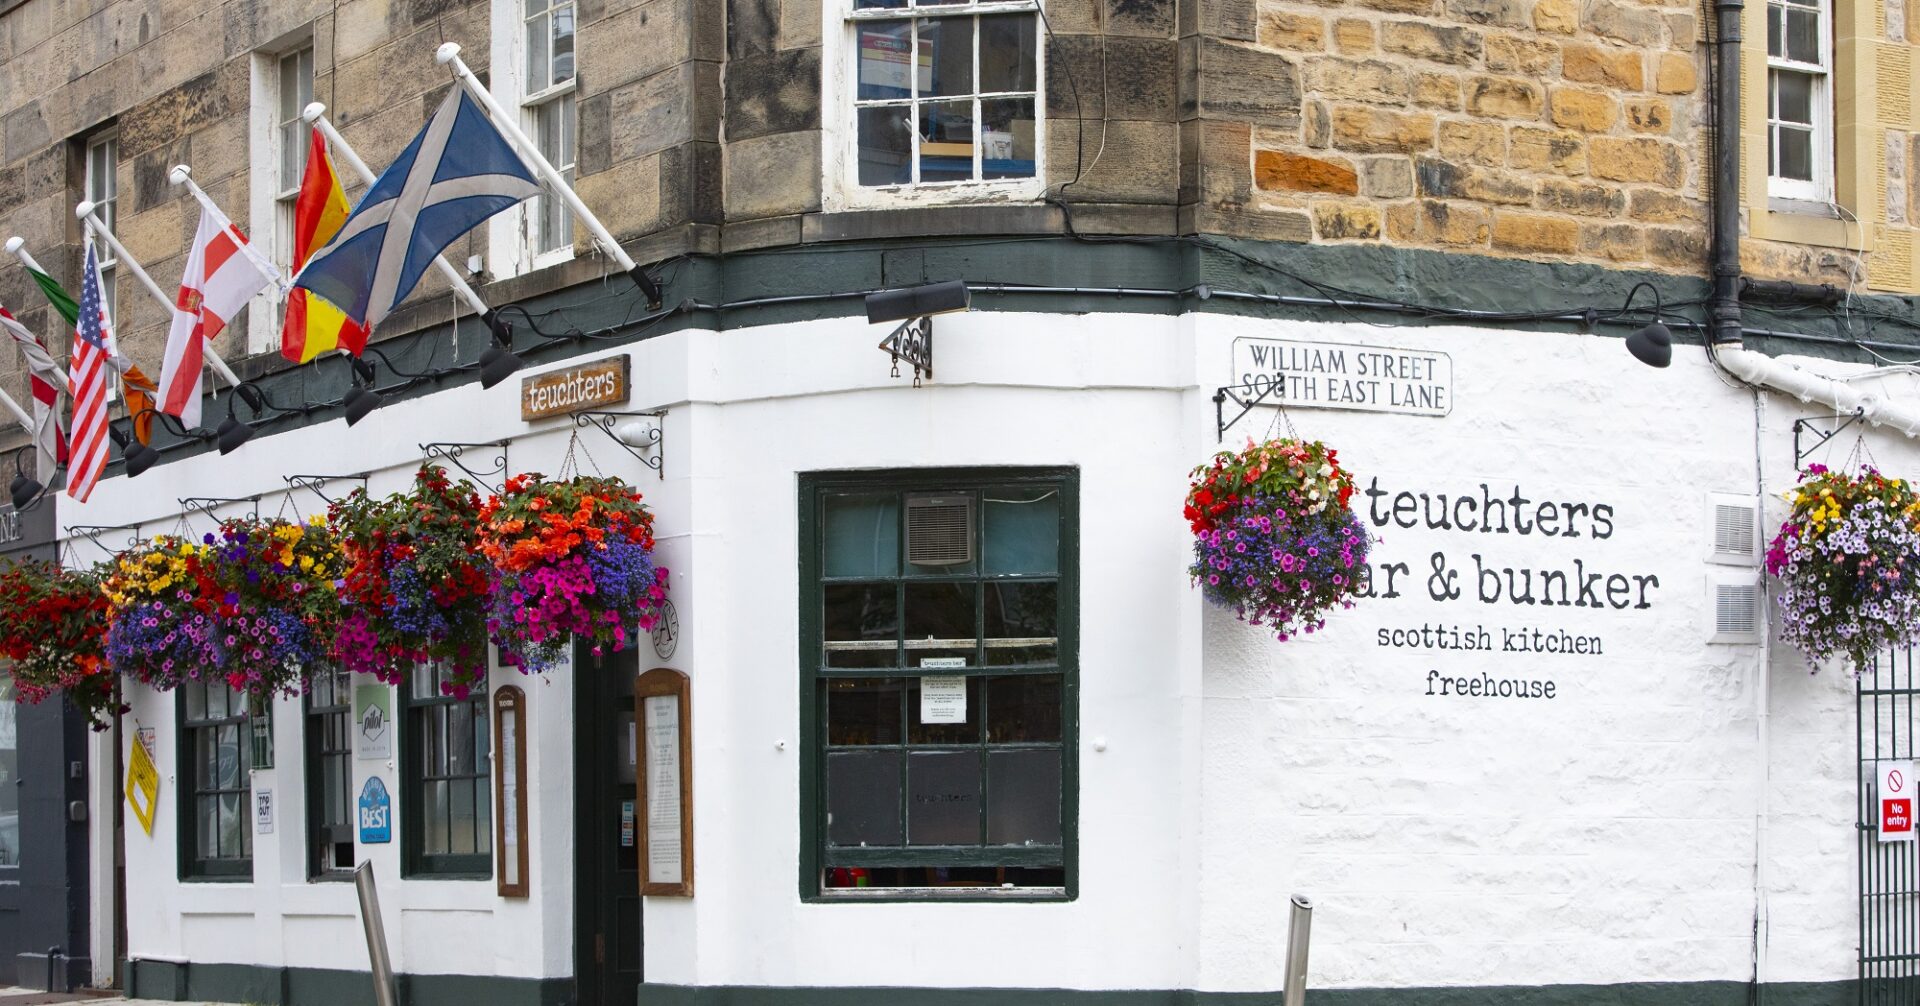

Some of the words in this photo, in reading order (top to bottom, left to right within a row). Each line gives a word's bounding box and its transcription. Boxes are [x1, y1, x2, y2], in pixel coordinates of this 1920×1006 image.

[1250, 345, 1347, 374] WILLIAM
[1357, 352, 1437, 381] STREET
[529, 369, 615, 412] teuchters
[1242, 373, 1317, 401] SOUTH
[1328, 378, 1380, 404] EAST
[1390, 382, 1445, 409] LANE
[1365, 476, 1614, 539] teuchters
[1352, 562, 1410, 599] ar
[1427, 551, 1461, 602] &
[1471, 553, 1660, 610] bunker
[1377, 623, 1492, 651] scottish
[1502, 627, 1603, 655] kitchen
[1425, 669, 1556, 699] freehouse
[363, 709, 384, 736] pilot
[258, 796, 270, 806] TOP
[258, 806, 270, 816] OUT
[1892, 804, 1903, 814] No
[361, 806, 388, 828] BEST
[1887, 816, 1907, 827] entry
